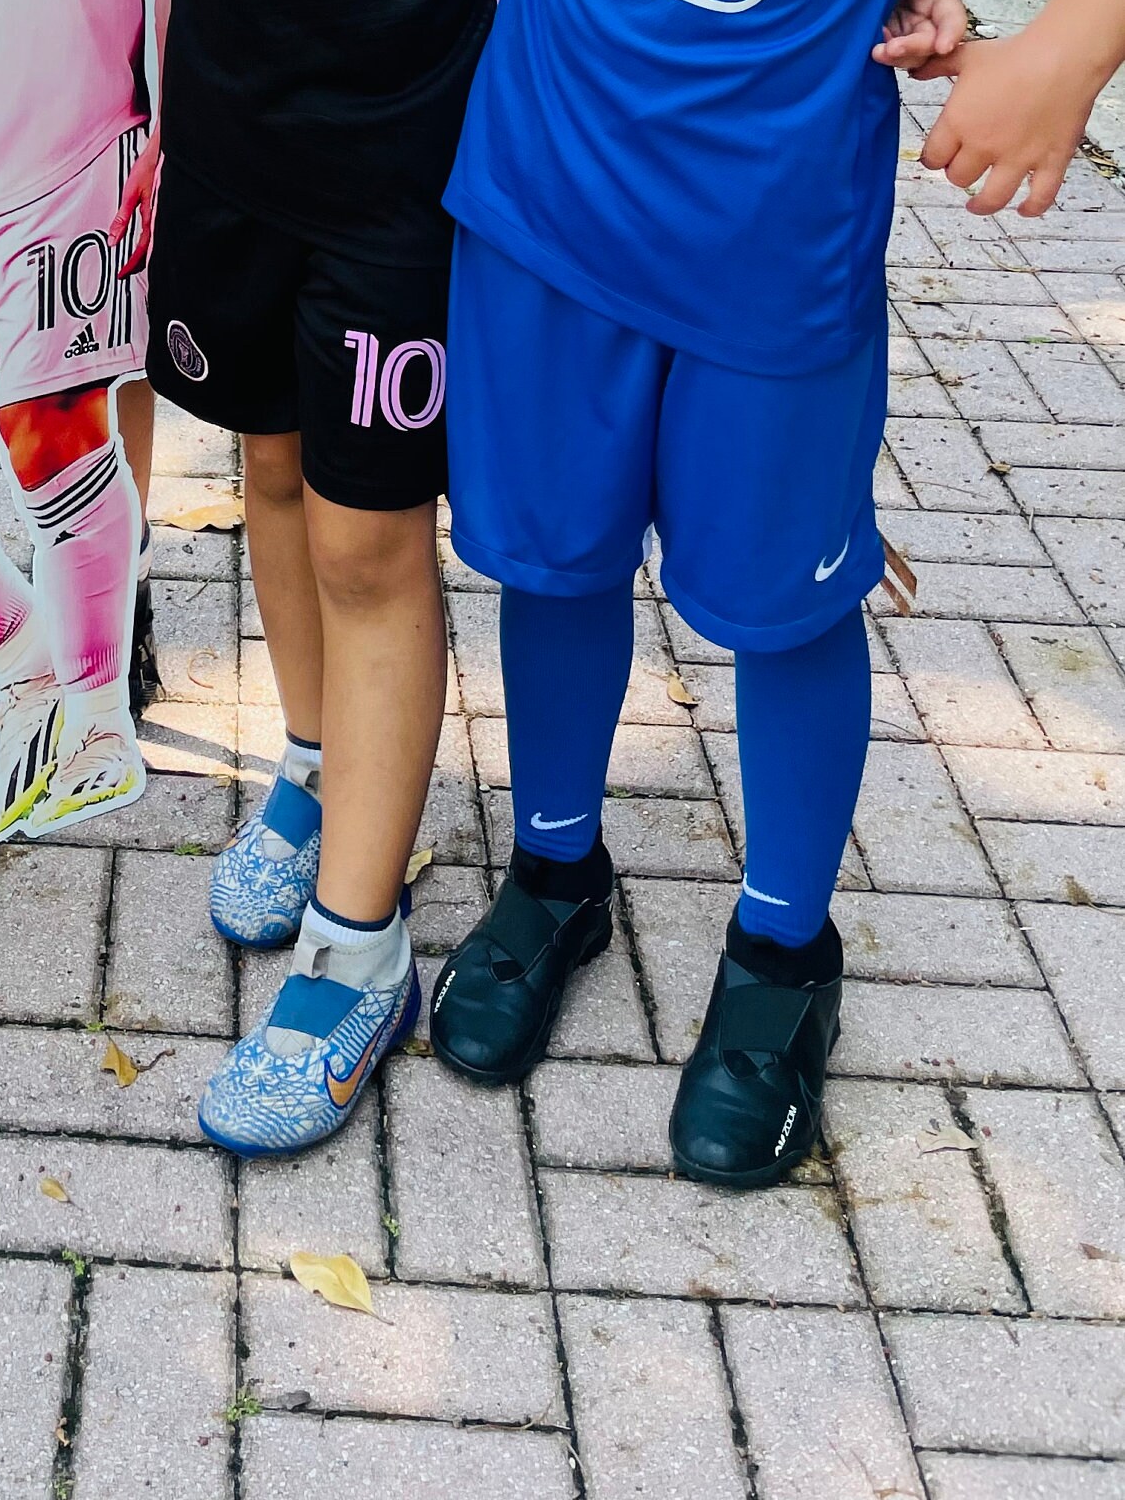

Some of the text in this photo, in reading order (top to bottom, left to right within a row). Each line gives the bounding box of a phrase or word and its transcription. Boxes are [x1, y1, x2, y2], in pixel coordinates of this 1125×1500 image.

[26, 229, 112, 332] 10
[343, 329, 447, 431] 10
[781, 1104, 797, 1137] ZOOM
